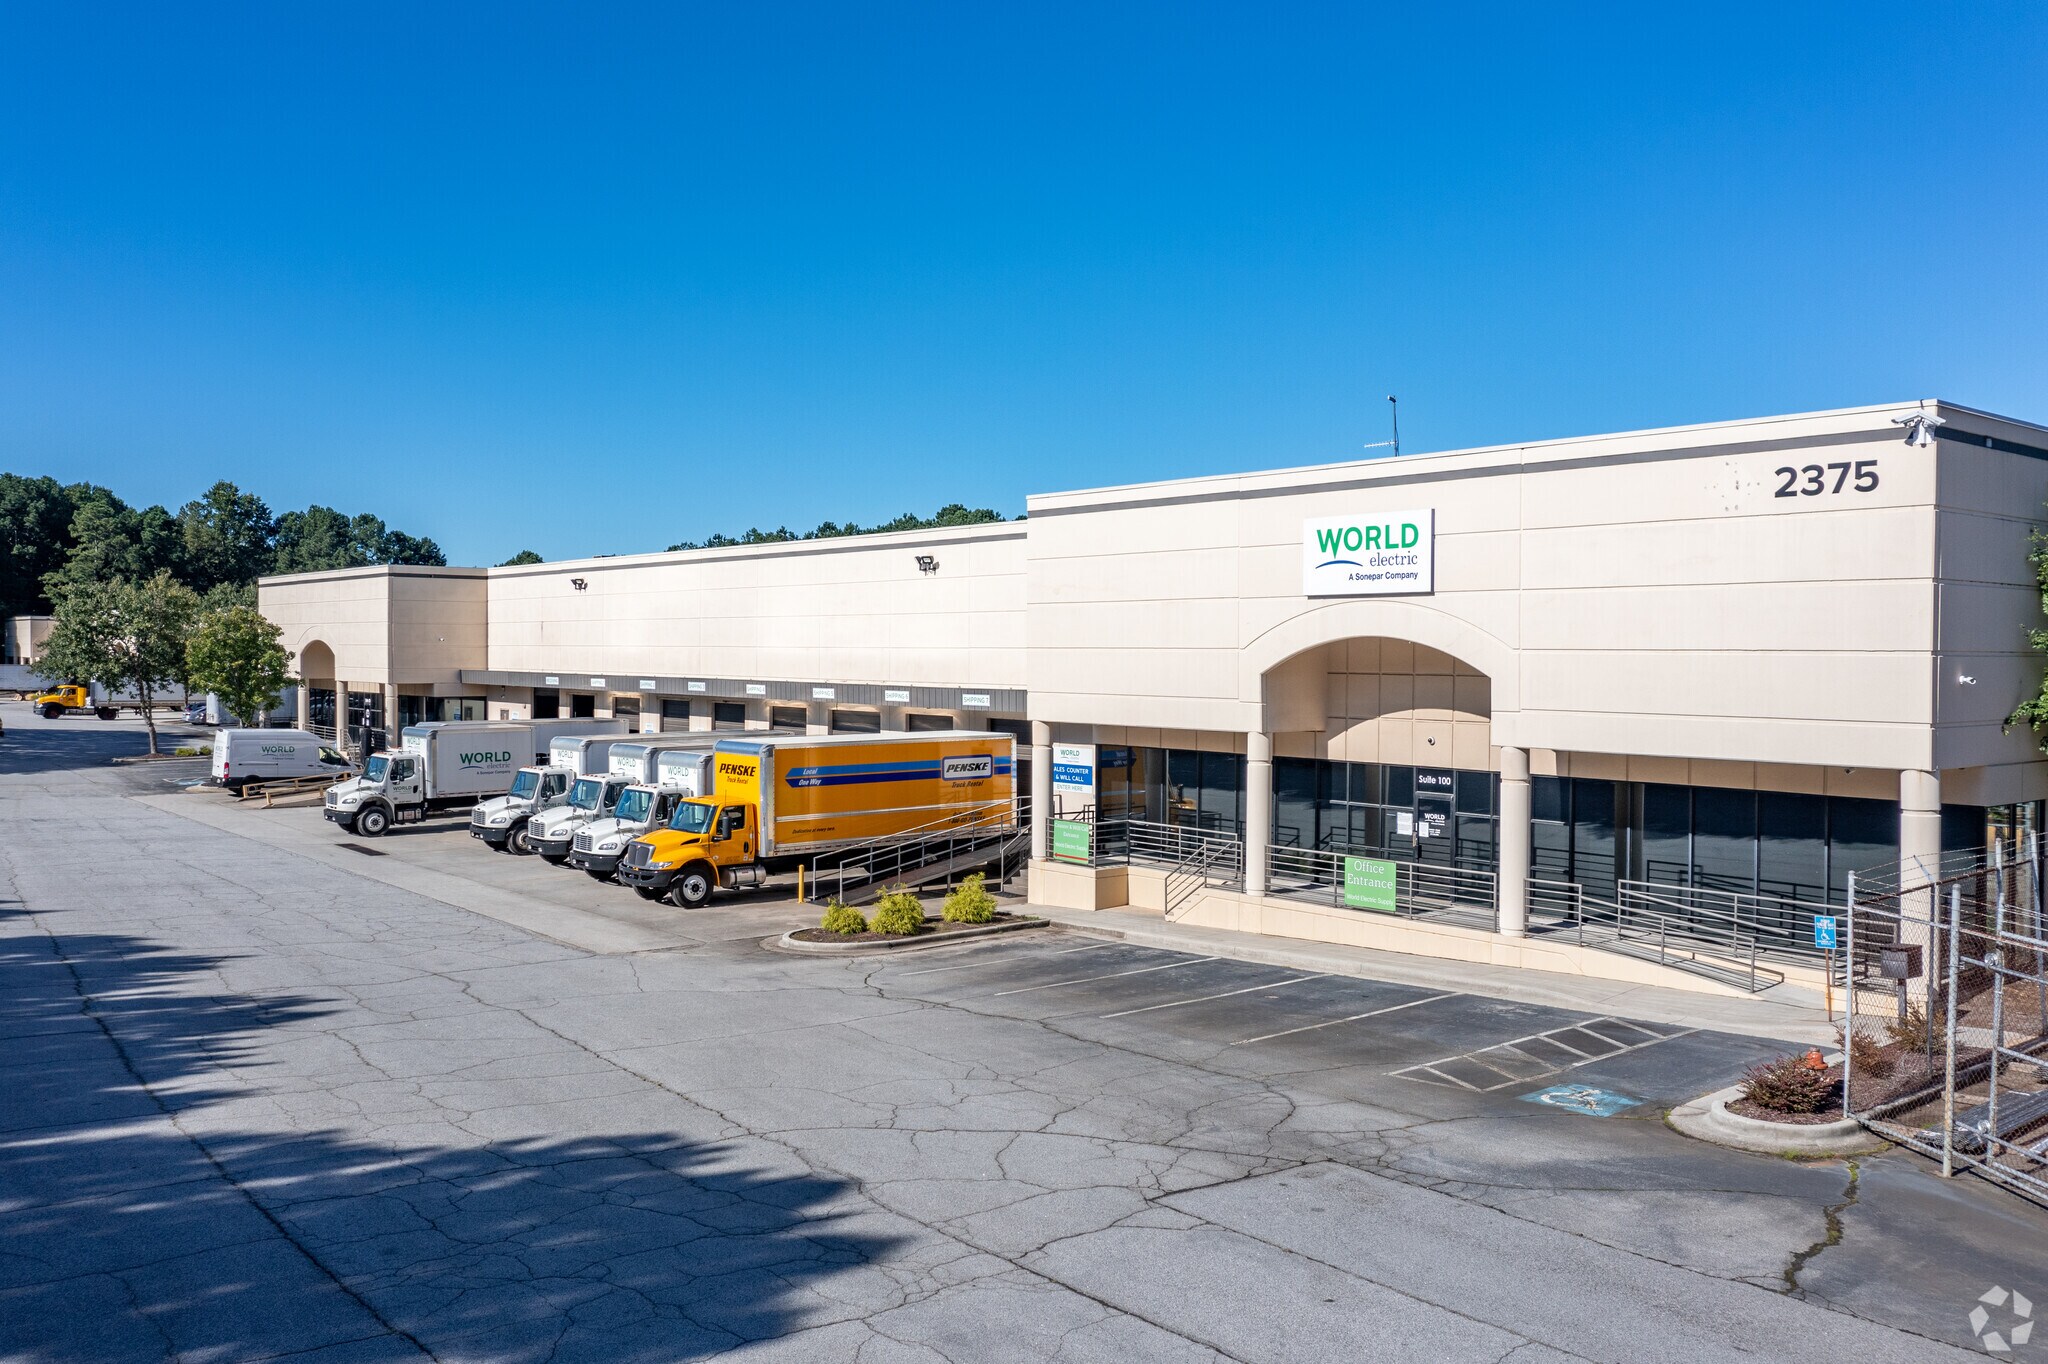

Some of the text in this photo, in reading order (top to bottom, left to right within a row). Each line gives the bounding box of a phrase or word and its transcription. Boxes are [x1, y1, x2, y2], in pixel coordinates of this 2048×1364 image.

[1774, 459, 1879, 498] 2375
[1316, 523, 1419, 559] WORLD
[1369, 550, 1418, 567] electric
[1348, 571, 1418, 581] A Sonepar Company
[886, 692, 904, 700] SHIPPING
[964, 696, 985, 705] SHIPPING
[261, 745, 295, 754] WORLD
[557, 750, 574, 759] WORLD
[1060, 749, 1080, 757] WORLD
[459, 751, 511, 765] WORLD
[617, 757, 637, 767] WORLD
[667, 766, 689, 777] WORLD
[719, 763, 756, 777] PENSKE
[946, 761, 989, 773] PENSKE
[1066, 767, 1089, 775] COUNTER
[726, 775, 736, 783] Truck
[810, 778, 822, 786] Way
[1418, 774, 1451, 786] Suite 100
[1353, 860, 1385, 875] Office
[1347, 872, 1393, 890] Entrance
[1346, 893, 1393, 907] World Electric Supply
